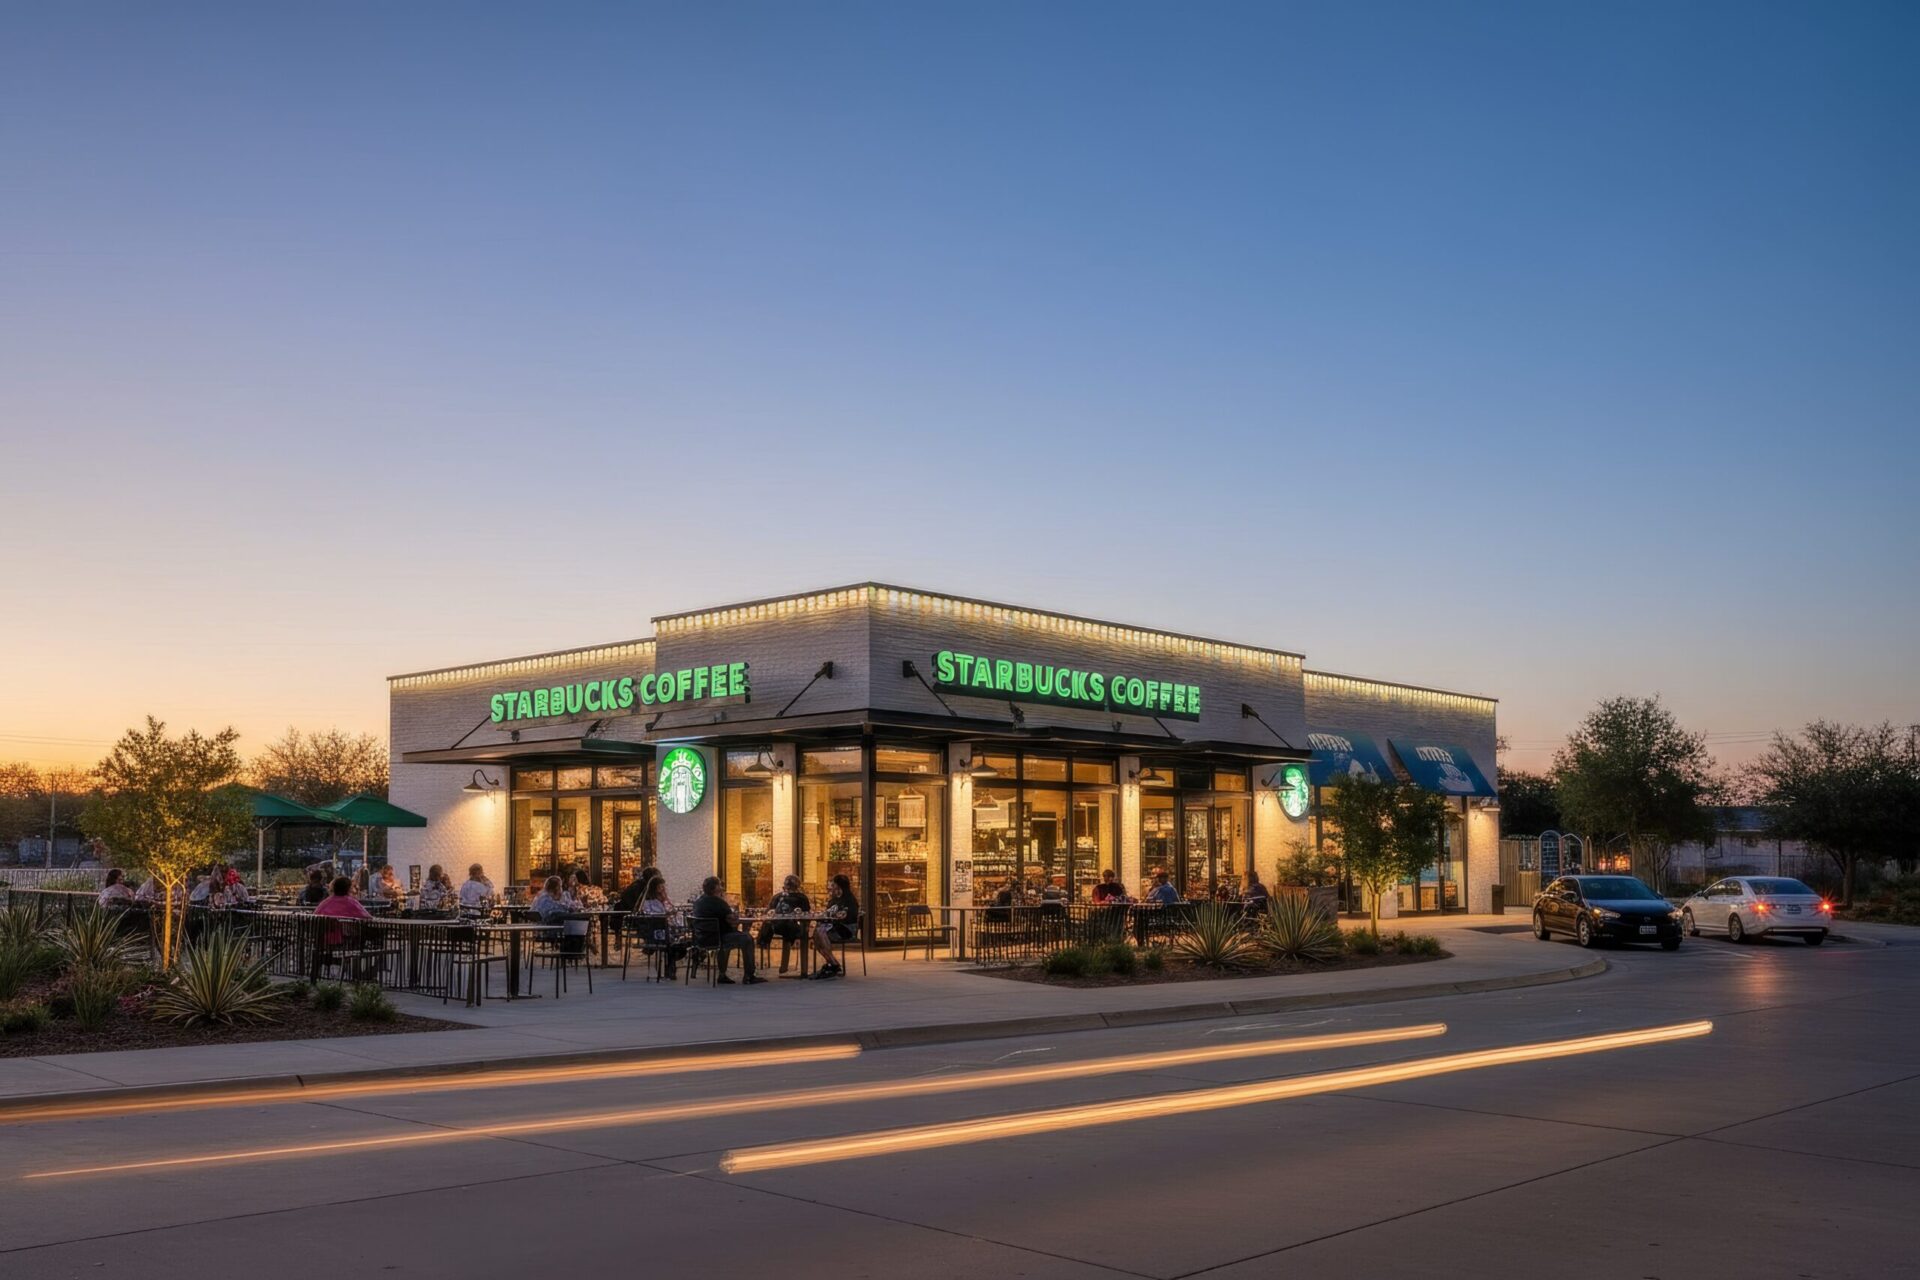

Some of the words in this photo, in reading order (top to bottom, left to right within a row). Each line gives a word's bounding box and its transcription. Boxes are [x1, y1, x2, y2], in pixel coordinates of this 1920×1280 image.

[490, 677, 633, 722] STARBUCKS
[640, 662, 746, 705] COFFEE
[937, 650, 1105, 702] STARBUCKS
[1111, 675, 1201, 714] COFFEE
